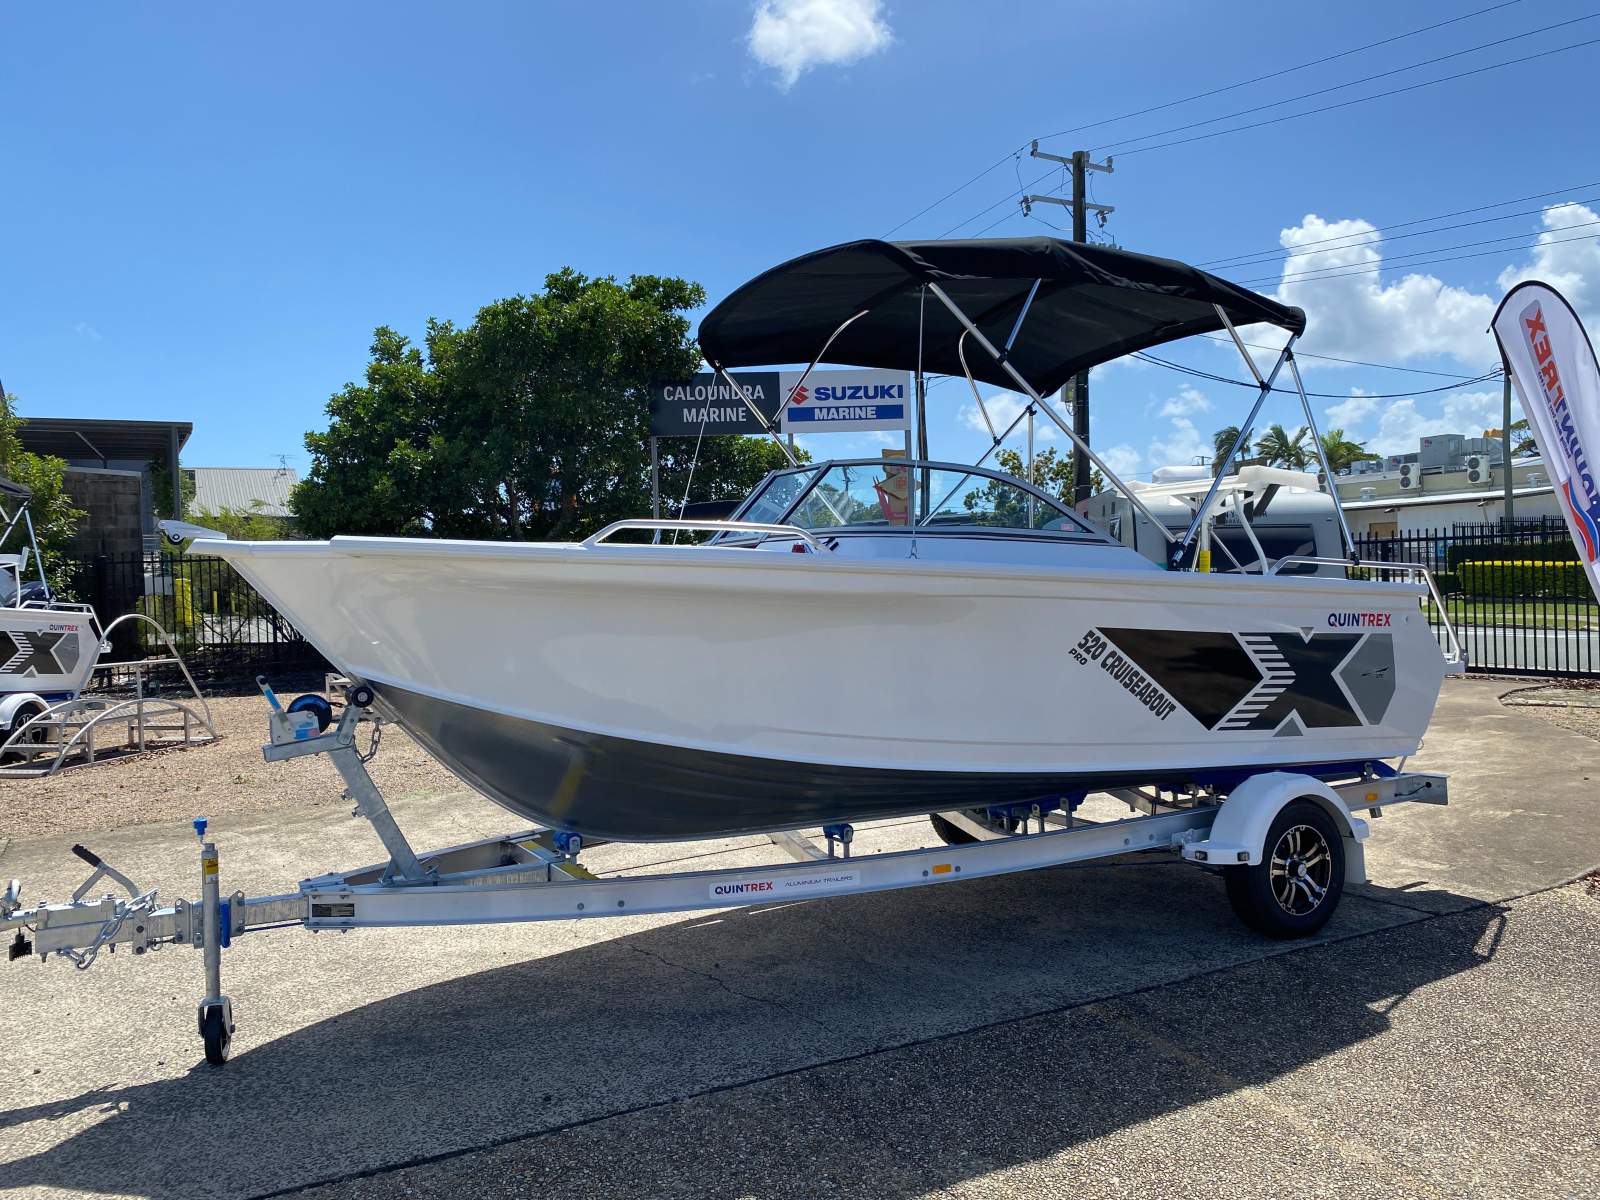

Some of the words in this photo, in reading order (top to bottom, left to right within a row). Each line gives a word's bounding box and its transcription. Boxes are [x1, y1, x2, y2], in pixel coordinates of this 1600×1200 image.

[663, 385, 765, 401] CALOUNDRA
[814, 384, 904, 401] SUZUKI
[683, 407, 747, 422] MARINE
[814, 406, 877, 420] MARINE
[1327, 612, 1392, 627] QUINTREX
[1068, 647, 1088, 666] PRO
[1077, 629, 1108, 661] 520
[1101, 650, 1177, 721] CRUISEABOUT
[714, 880, 773, 896] QUINTREX
